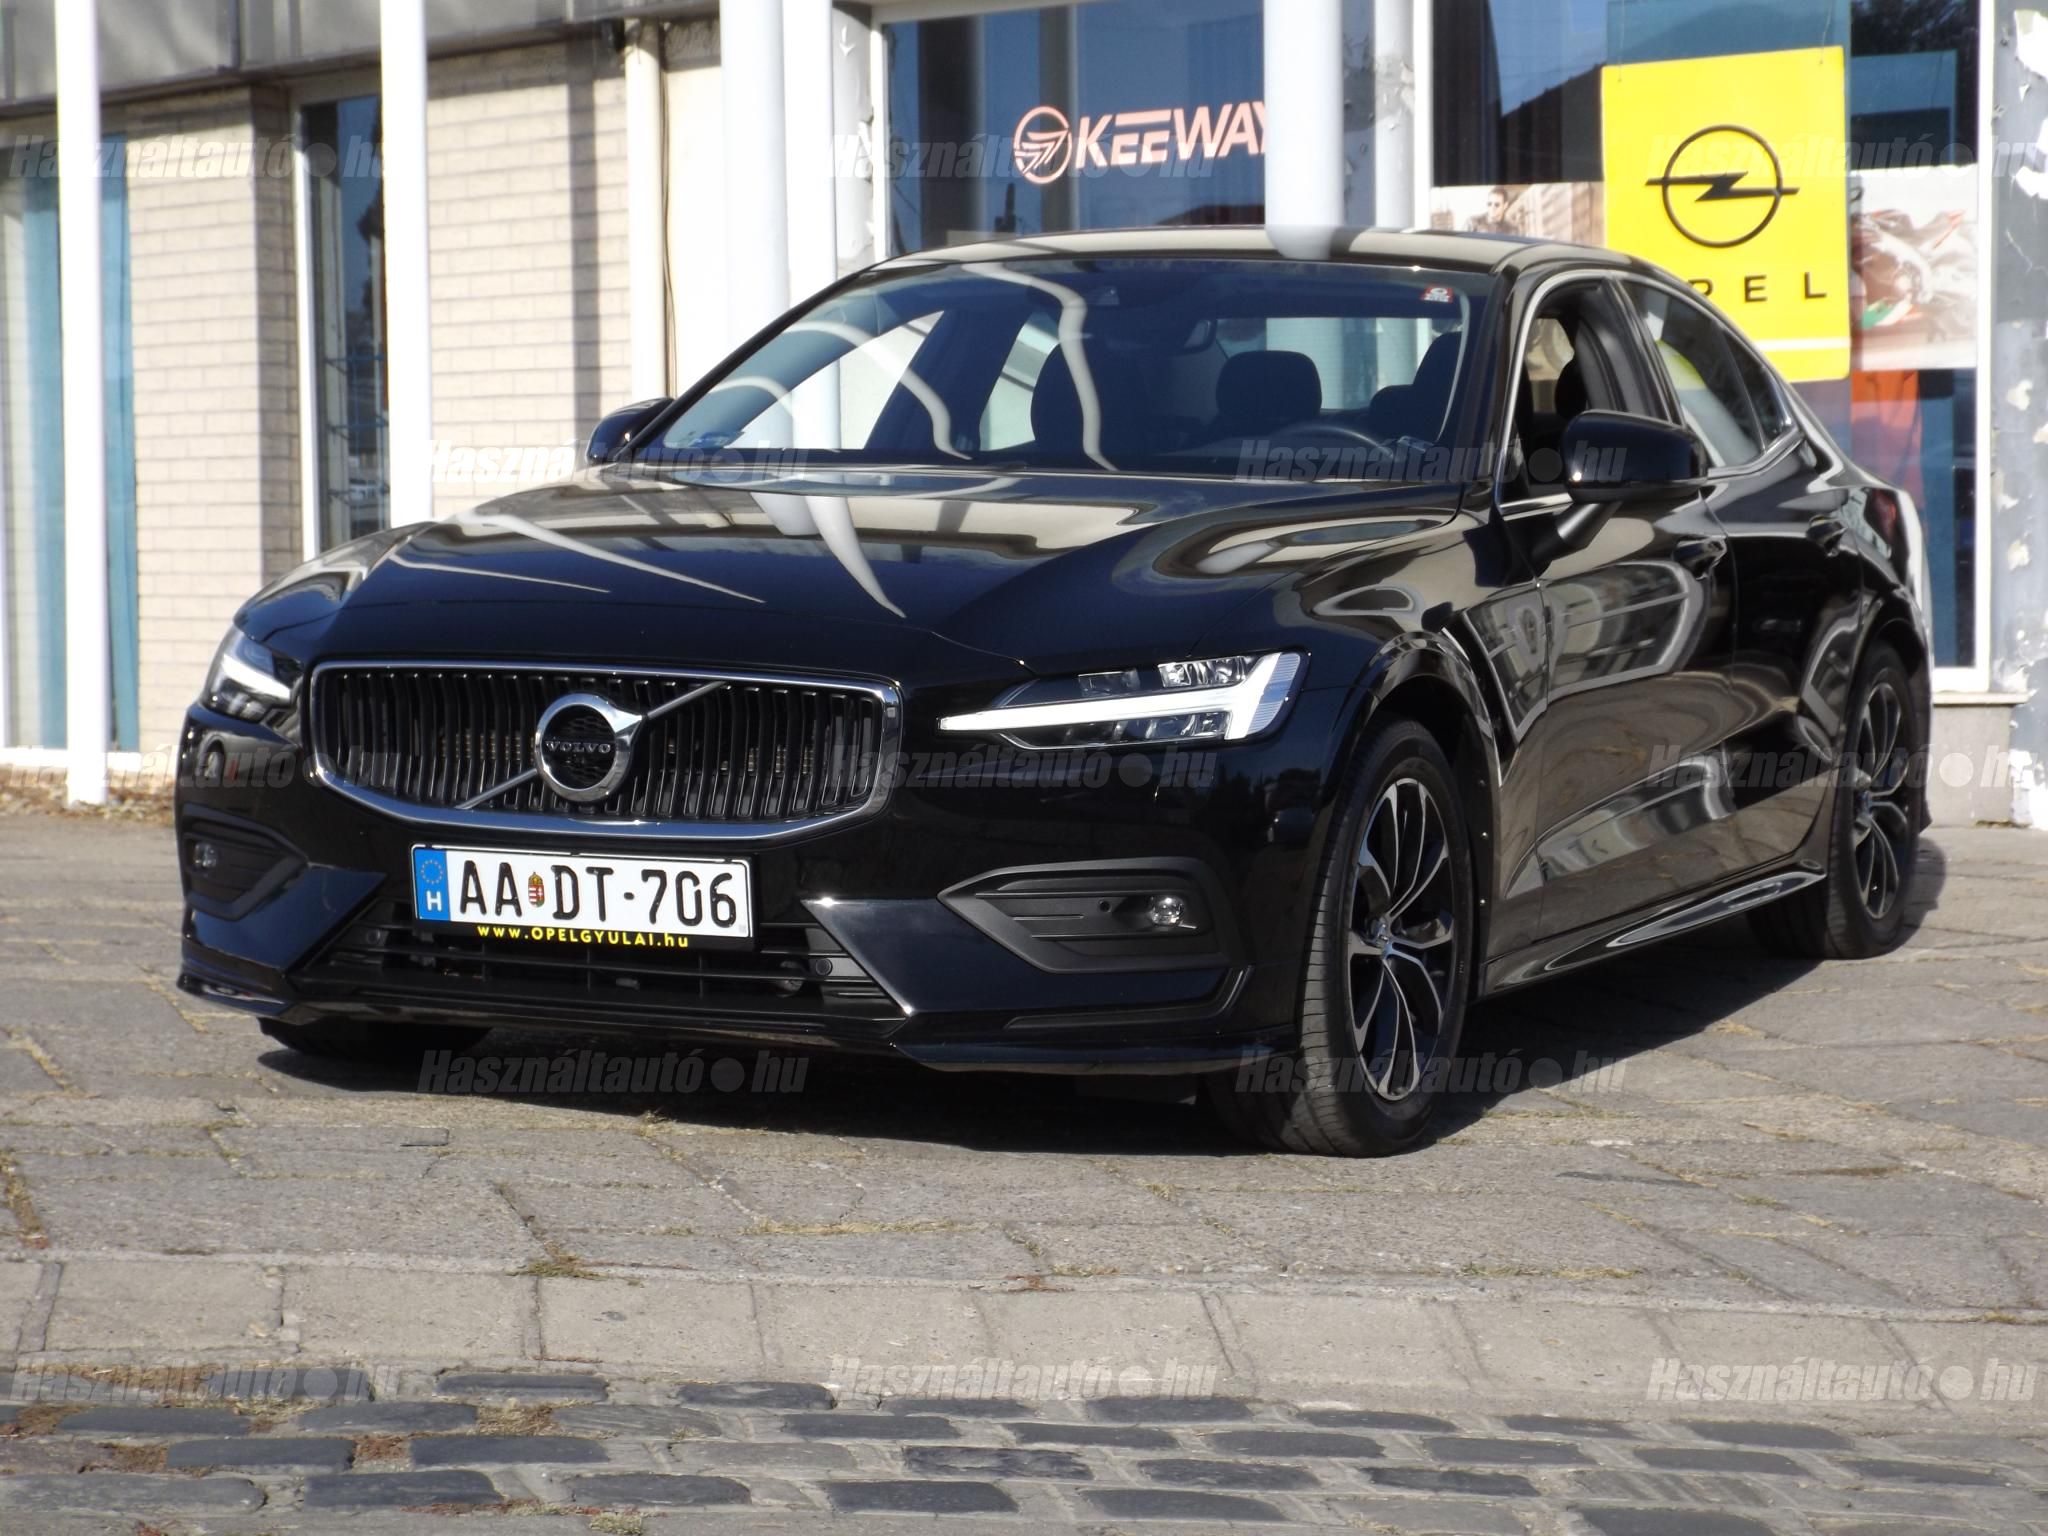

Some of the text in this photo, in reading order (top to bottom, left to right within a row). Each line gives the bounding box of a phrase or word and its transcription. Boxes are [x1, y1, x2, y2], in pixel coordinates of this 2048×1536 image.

[545, 740, 611, 753] VOLVO
[459, 860, 522, 917] AA
[426, 890, 443, 912] H
[478, 925, 689, 948] www.OPELGYULAI.hu
